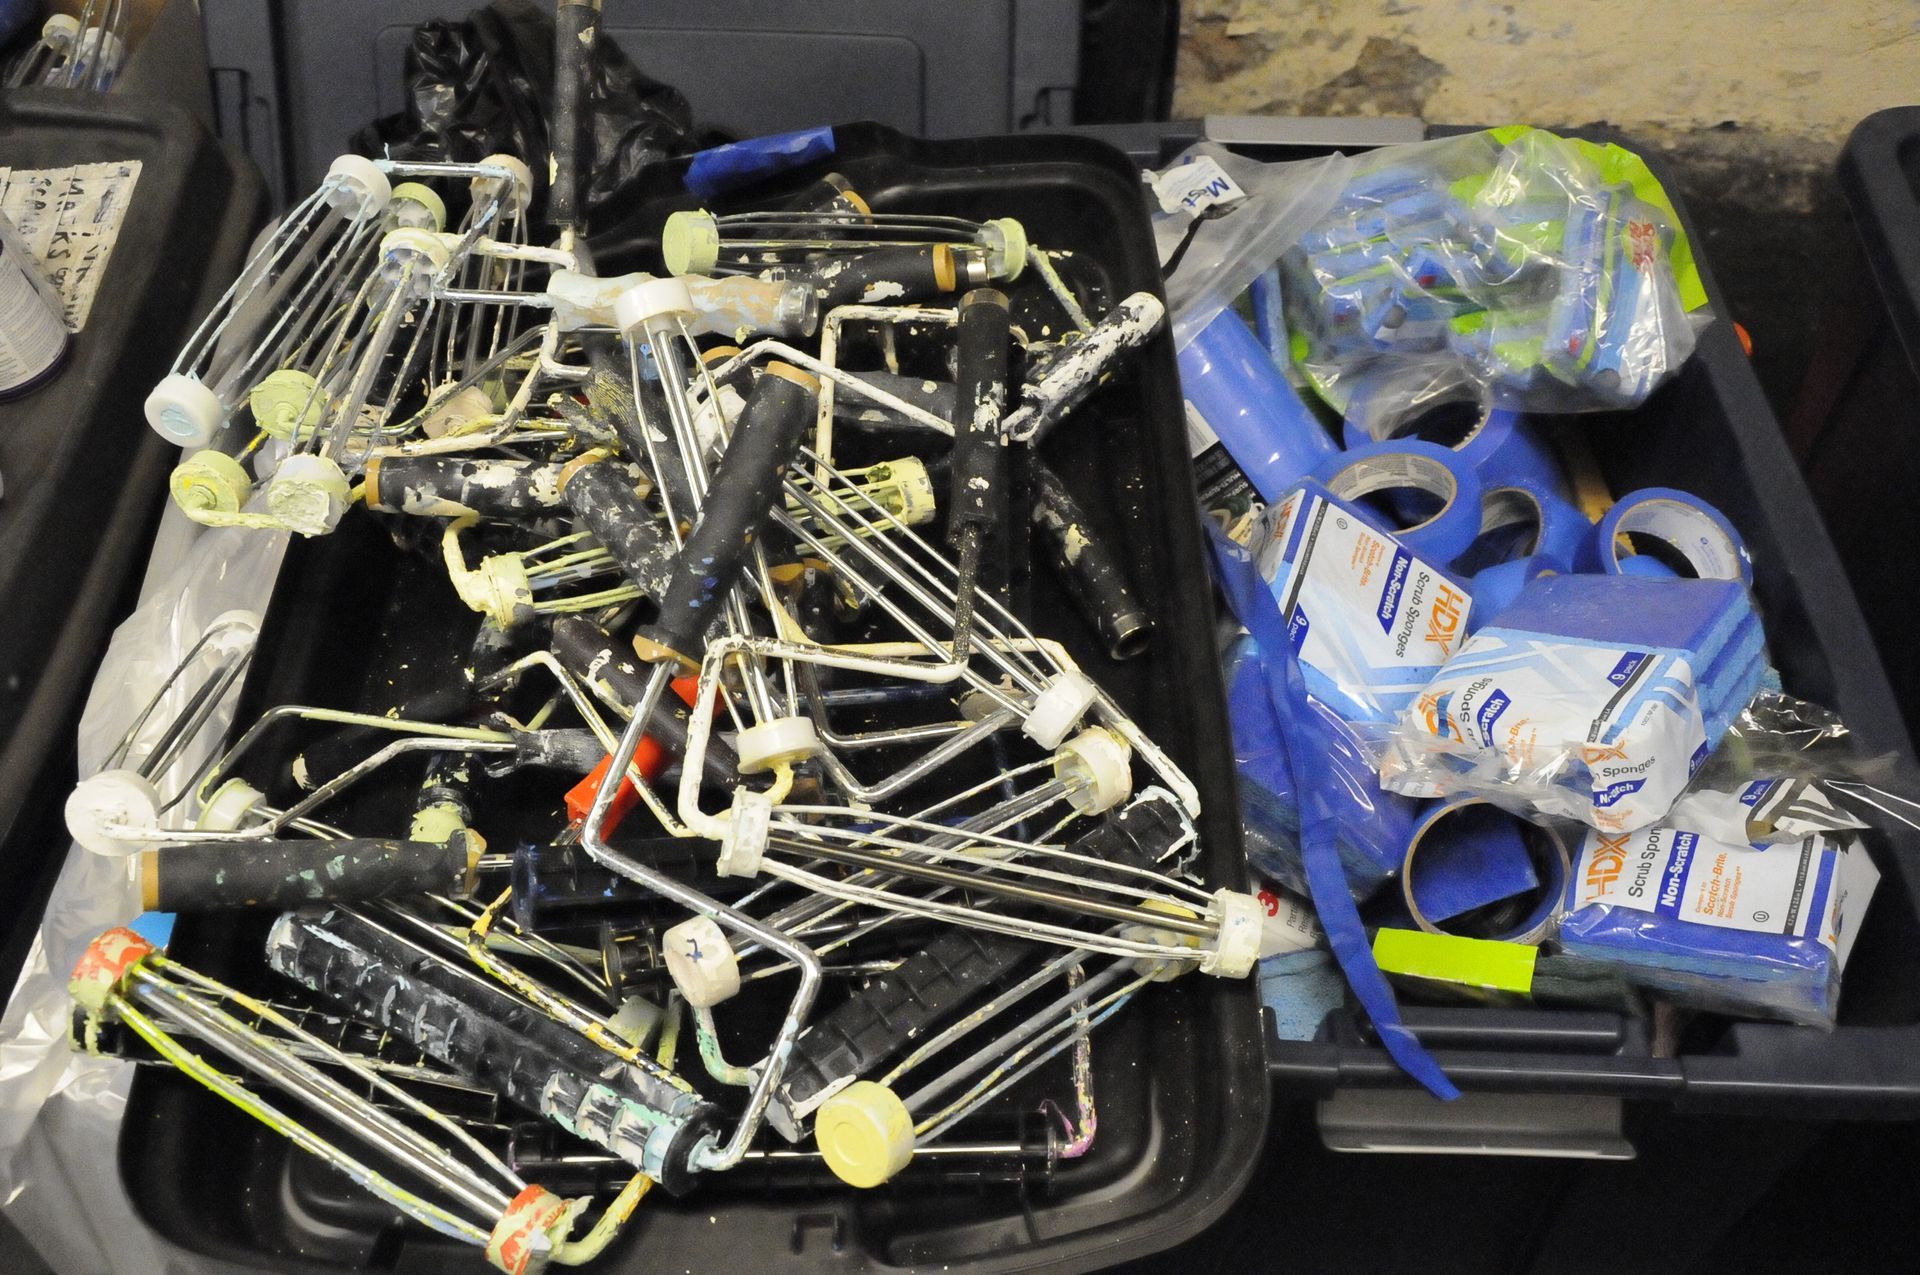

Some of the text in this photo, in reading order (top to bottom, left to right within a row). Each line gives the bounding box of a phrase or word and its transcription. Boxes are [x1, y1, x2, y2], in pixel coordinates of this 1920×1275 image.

[1381, 556, 1409, 620] Non-Scratch
[1395, 571, 1431, 659] Scrub Sponges
[1295, 615, 1308, 627] 9
[1424, 583, 1465, 657] HDX
[1459, 677, 1493, 723] Sponges
[1611, 673, 1626, 682] 9
[1602, 755, 1656, 778] Sponges
[1586, 832, 1632, 900] HDX
[1628, 862, 1653, 898] Scrub
[1661, 832, 1693, 908] Non-Scratch
